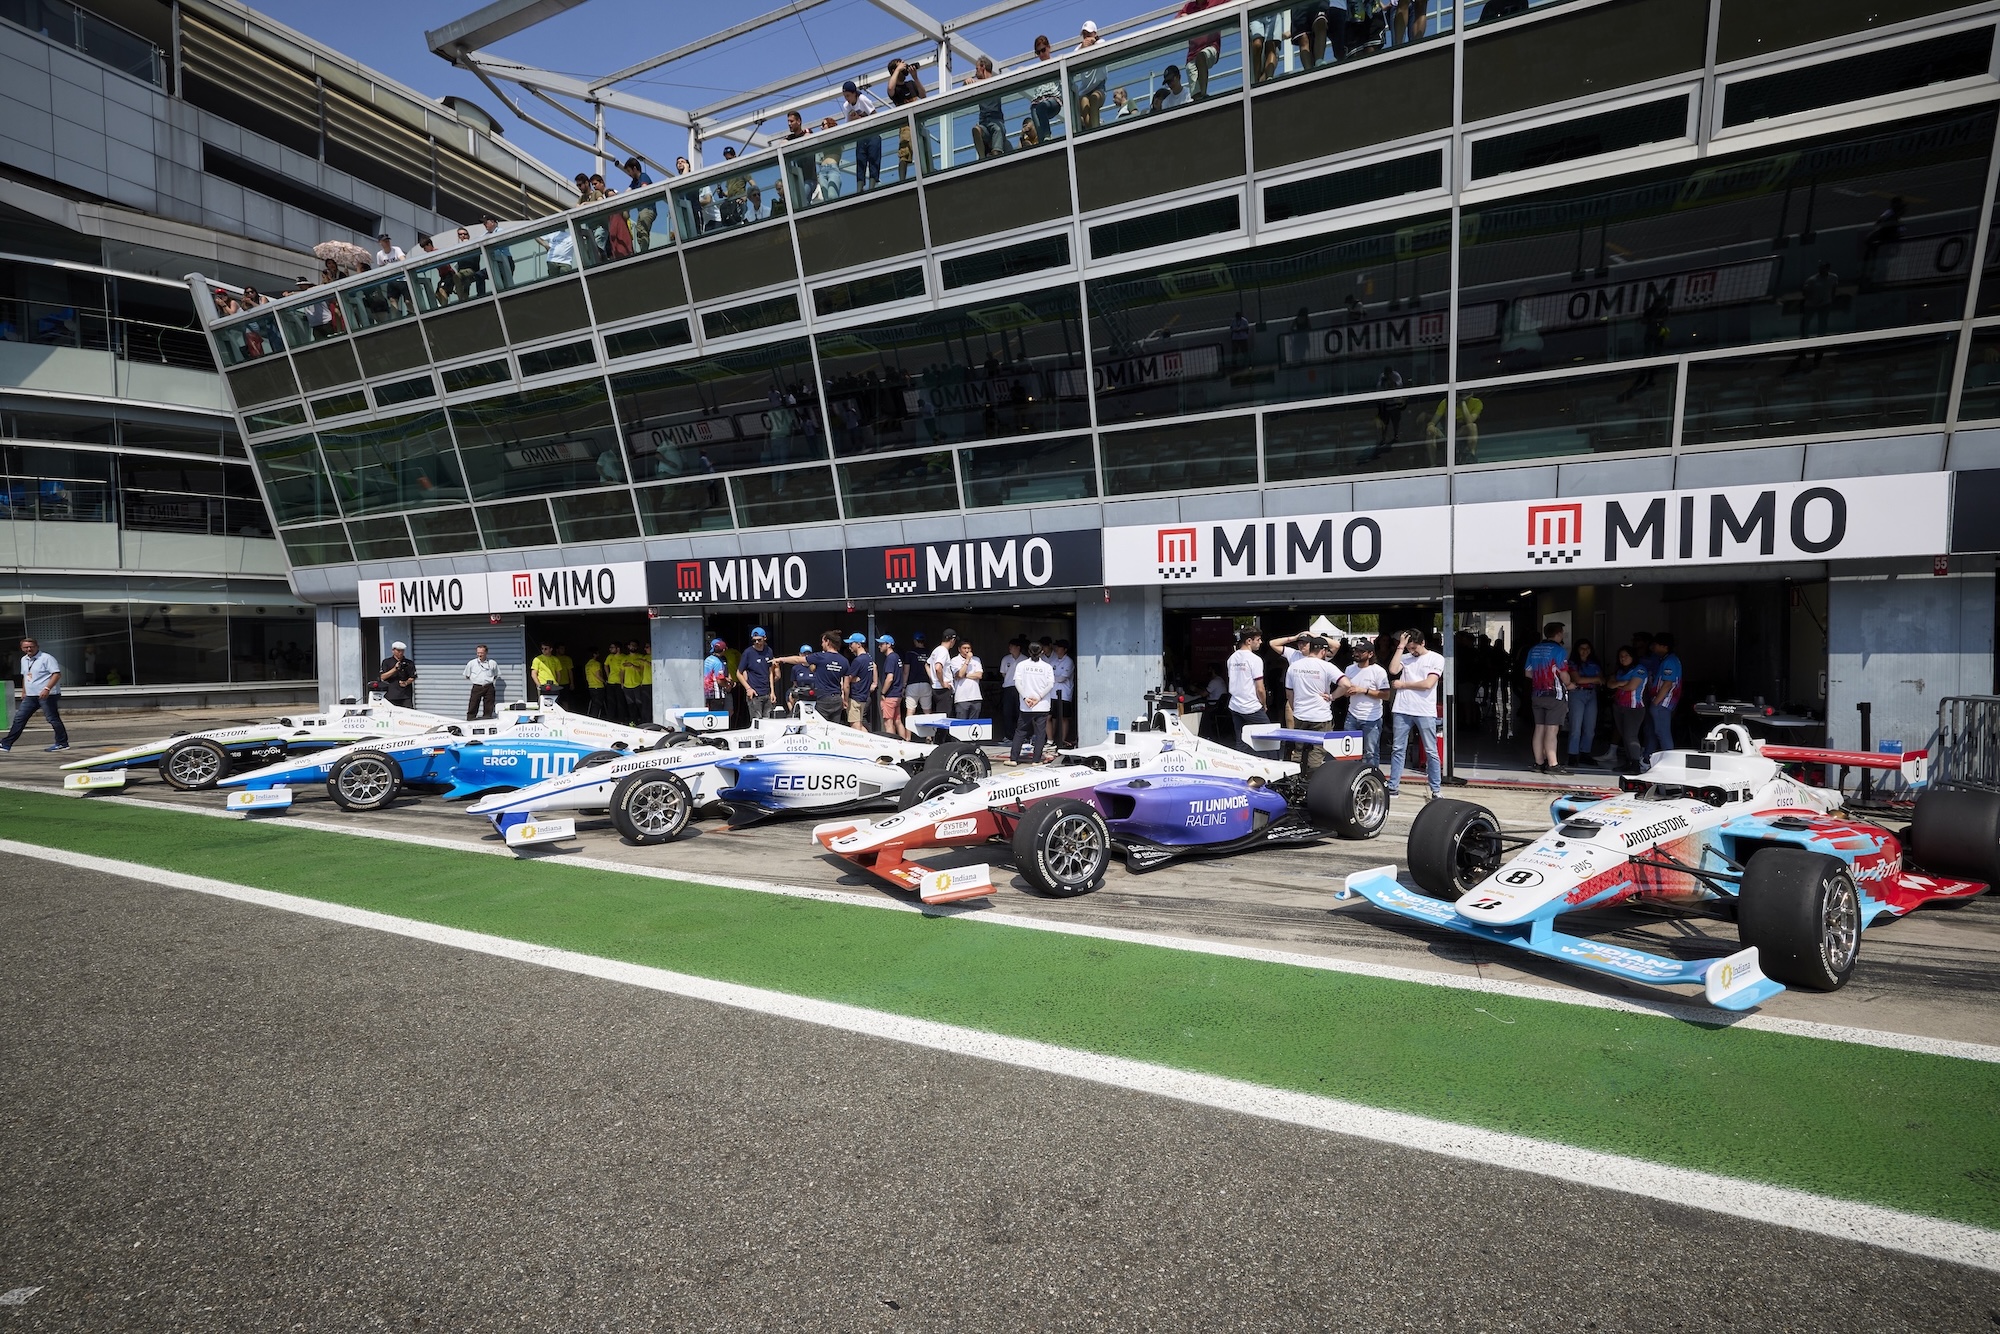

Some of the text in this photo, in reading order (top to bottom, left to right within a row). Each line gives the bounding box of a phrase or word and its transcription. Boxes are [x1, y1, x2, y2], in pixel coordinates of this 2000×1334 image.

[1605, 486, 1848, 563] MIMO
[1213, 517, 1382, 578] MIMO
[926, 536, 1053, 591] MIMO
[1935, 556, 1948, 569] 55
[708, 555, 808, 600] MIMO
[538, 567, 616, 607] MIMO
[400, 578, 464, 613] MIMO
[1344, 737, 1351, 752] 6
[693, 750, 717, 758] dSPACE
[483, 757, 518, 767] ERGO
[527, 753, 580, 779] TUM
[611, 755, 682, 774] BRIDGESTONE
[553, 777, 572, 787] aws
[1070, 770, 1094, 779] dSPACE
[988, 778, 1061, 802] BRIDGESTONE
[1206, 795, 1249, 811] UNIMORE
[1776, 798, 1793, 807] CISCO
[929, 807, 947, 819] aws
[1185, 812, 1227, 827] RACING
[537, 825, 562, 833] Indiana
[943, 828, 969, 836] Electronics
[944, 821, 969, 830] SYSTEM
[1620, 815, 1689, 848] BRIDGESTONE
[1516, 857, 1565, 870] CLEMSON
[1571, 859, 1593, 874] aws
[952, 874, 977, 882] Indiana
[1505, 871, 1533, 884] 8
[1392, 888, 1456, 913] INDIAN
[1577, 942, 1683, 971] INDIANA
[1732, 962, 1751, 975] Indiana
